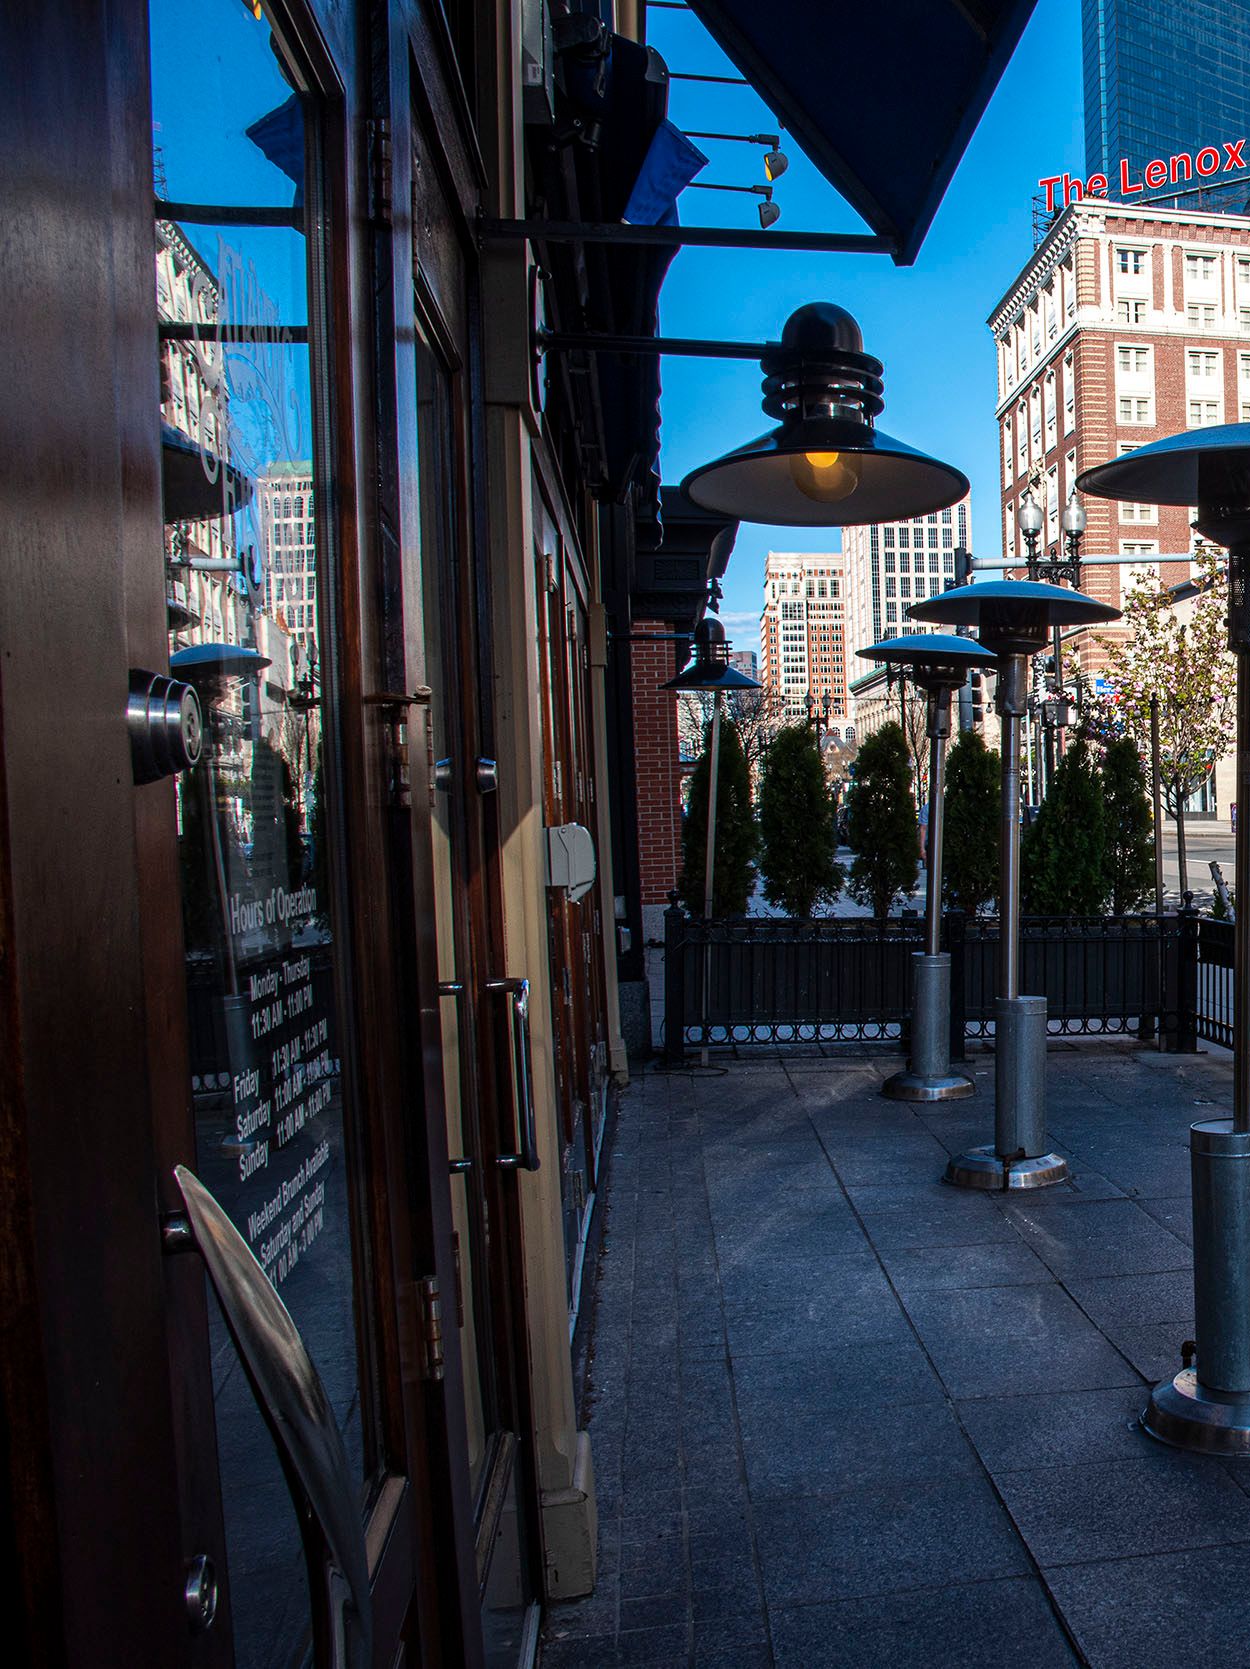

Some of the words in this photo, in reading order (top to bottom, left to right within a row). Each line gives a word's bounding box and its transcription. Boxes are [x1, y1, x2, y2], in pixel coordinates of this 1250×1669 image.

[1039, 173, 1108, 212] The
[1121, 140, 1246, 195] Lenox
[230, 892, 264, 935] Hours
[265, 887, 277, 925] of
[278, 882, 317, 928] Operation
[250, 968, 279, 1003] Monday
[282, 954, 311, 986] Thursday
[251, 1006, 272, 1040] 11:30
[271, 999, 284, 1029] AM
[287, 989, 303, 1019] 11:00
[303, 983, 313, 1010] PM
[233, 1068, 260, 1104] Friday
[272, 1043, 290, 1077] 11:30
[290, 1035, 301, 1065] AM
[318, 1017, 328, 1044] PM
[237, 1099, 271, 1143] Saturday
[274, 1078, 292, 1112] 11:00
[292, 1069, 303, 1100] AM
[240, 1139, 269, 1182] Sunday
[277, 1112, 294, 1148] 11:00
[294, 1103, 305, 1134] AM
[322, 1079, 332, 1107] PM
[248, 1186, 282, 1243] Weekend
[282, 1163, 306, 1207] Brunch
[305, 1139, 330, 1181] Available
[260, 1220, 292, 1270] Saturday
[291, 1199, 305, 1233] and
[304, 1180, 325, 1219] Sunday
[287, 1240, 299, 1273] AM
